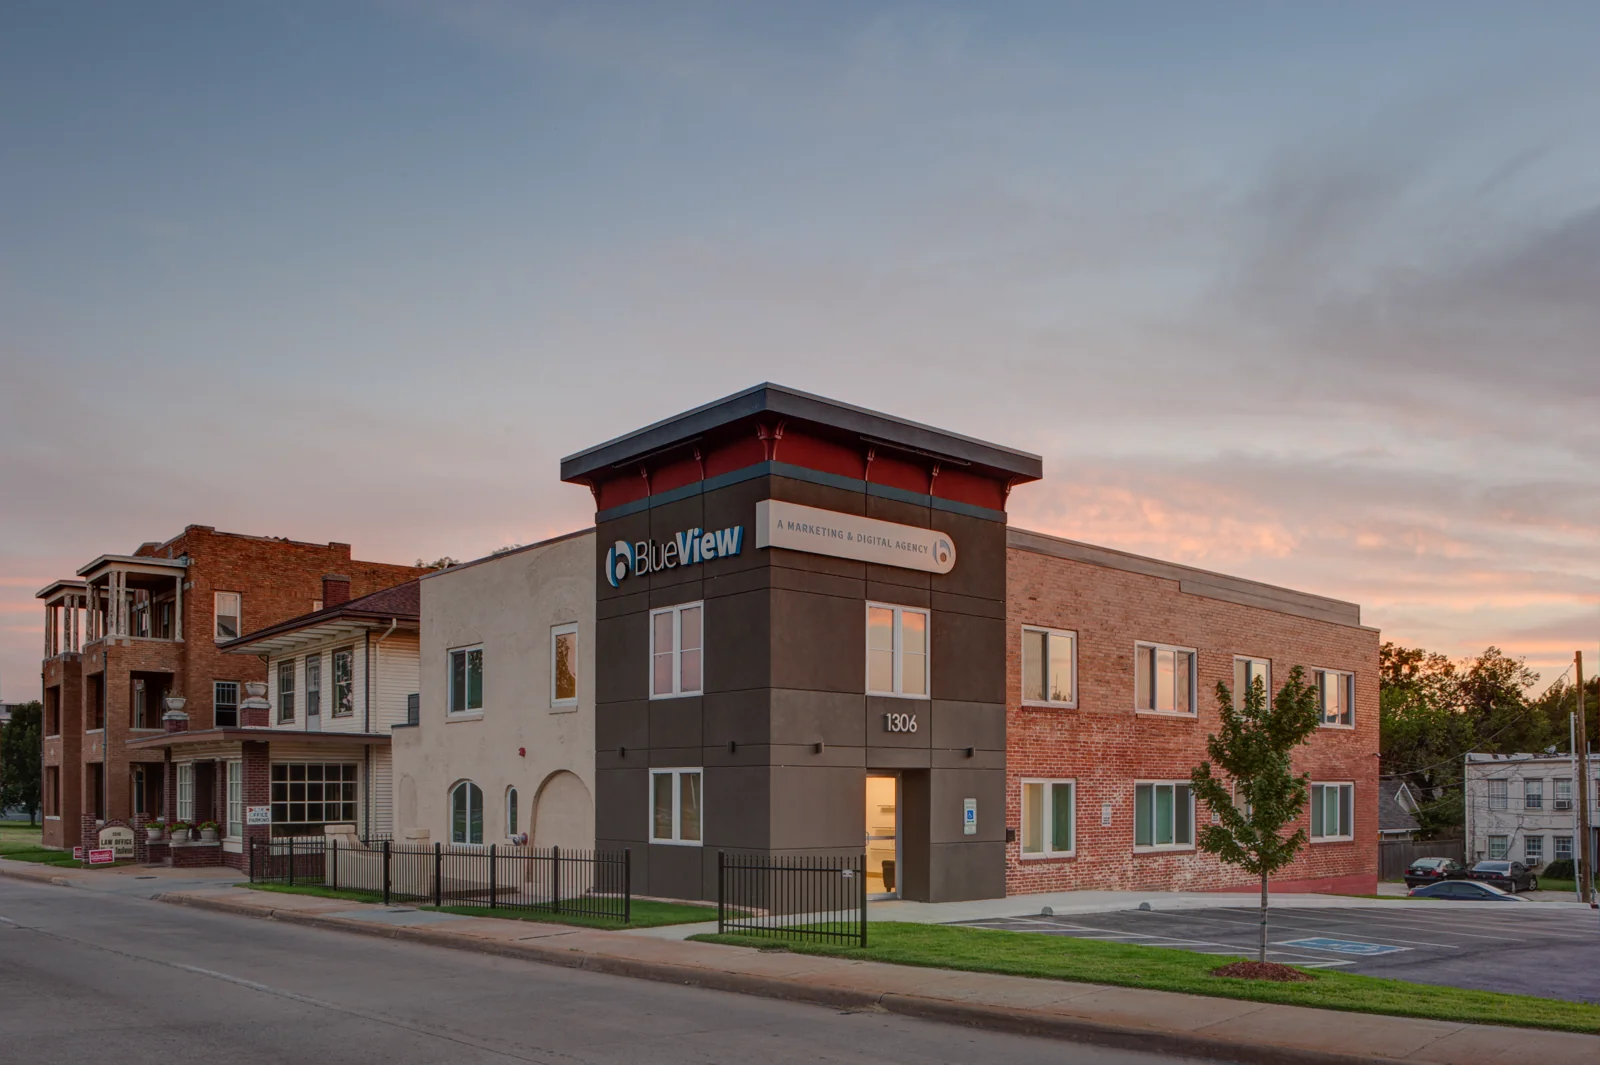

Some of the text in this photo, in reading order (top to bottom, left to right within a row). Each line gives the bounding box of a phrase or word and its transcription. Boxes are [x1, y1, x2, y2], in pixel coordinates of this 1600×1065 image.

[635, 525, 744, 576] BlueView
[777, 519, 928, 555] A MARKETING & DIGITAL AGENCY
[886, 713, 918, 733] 1306
